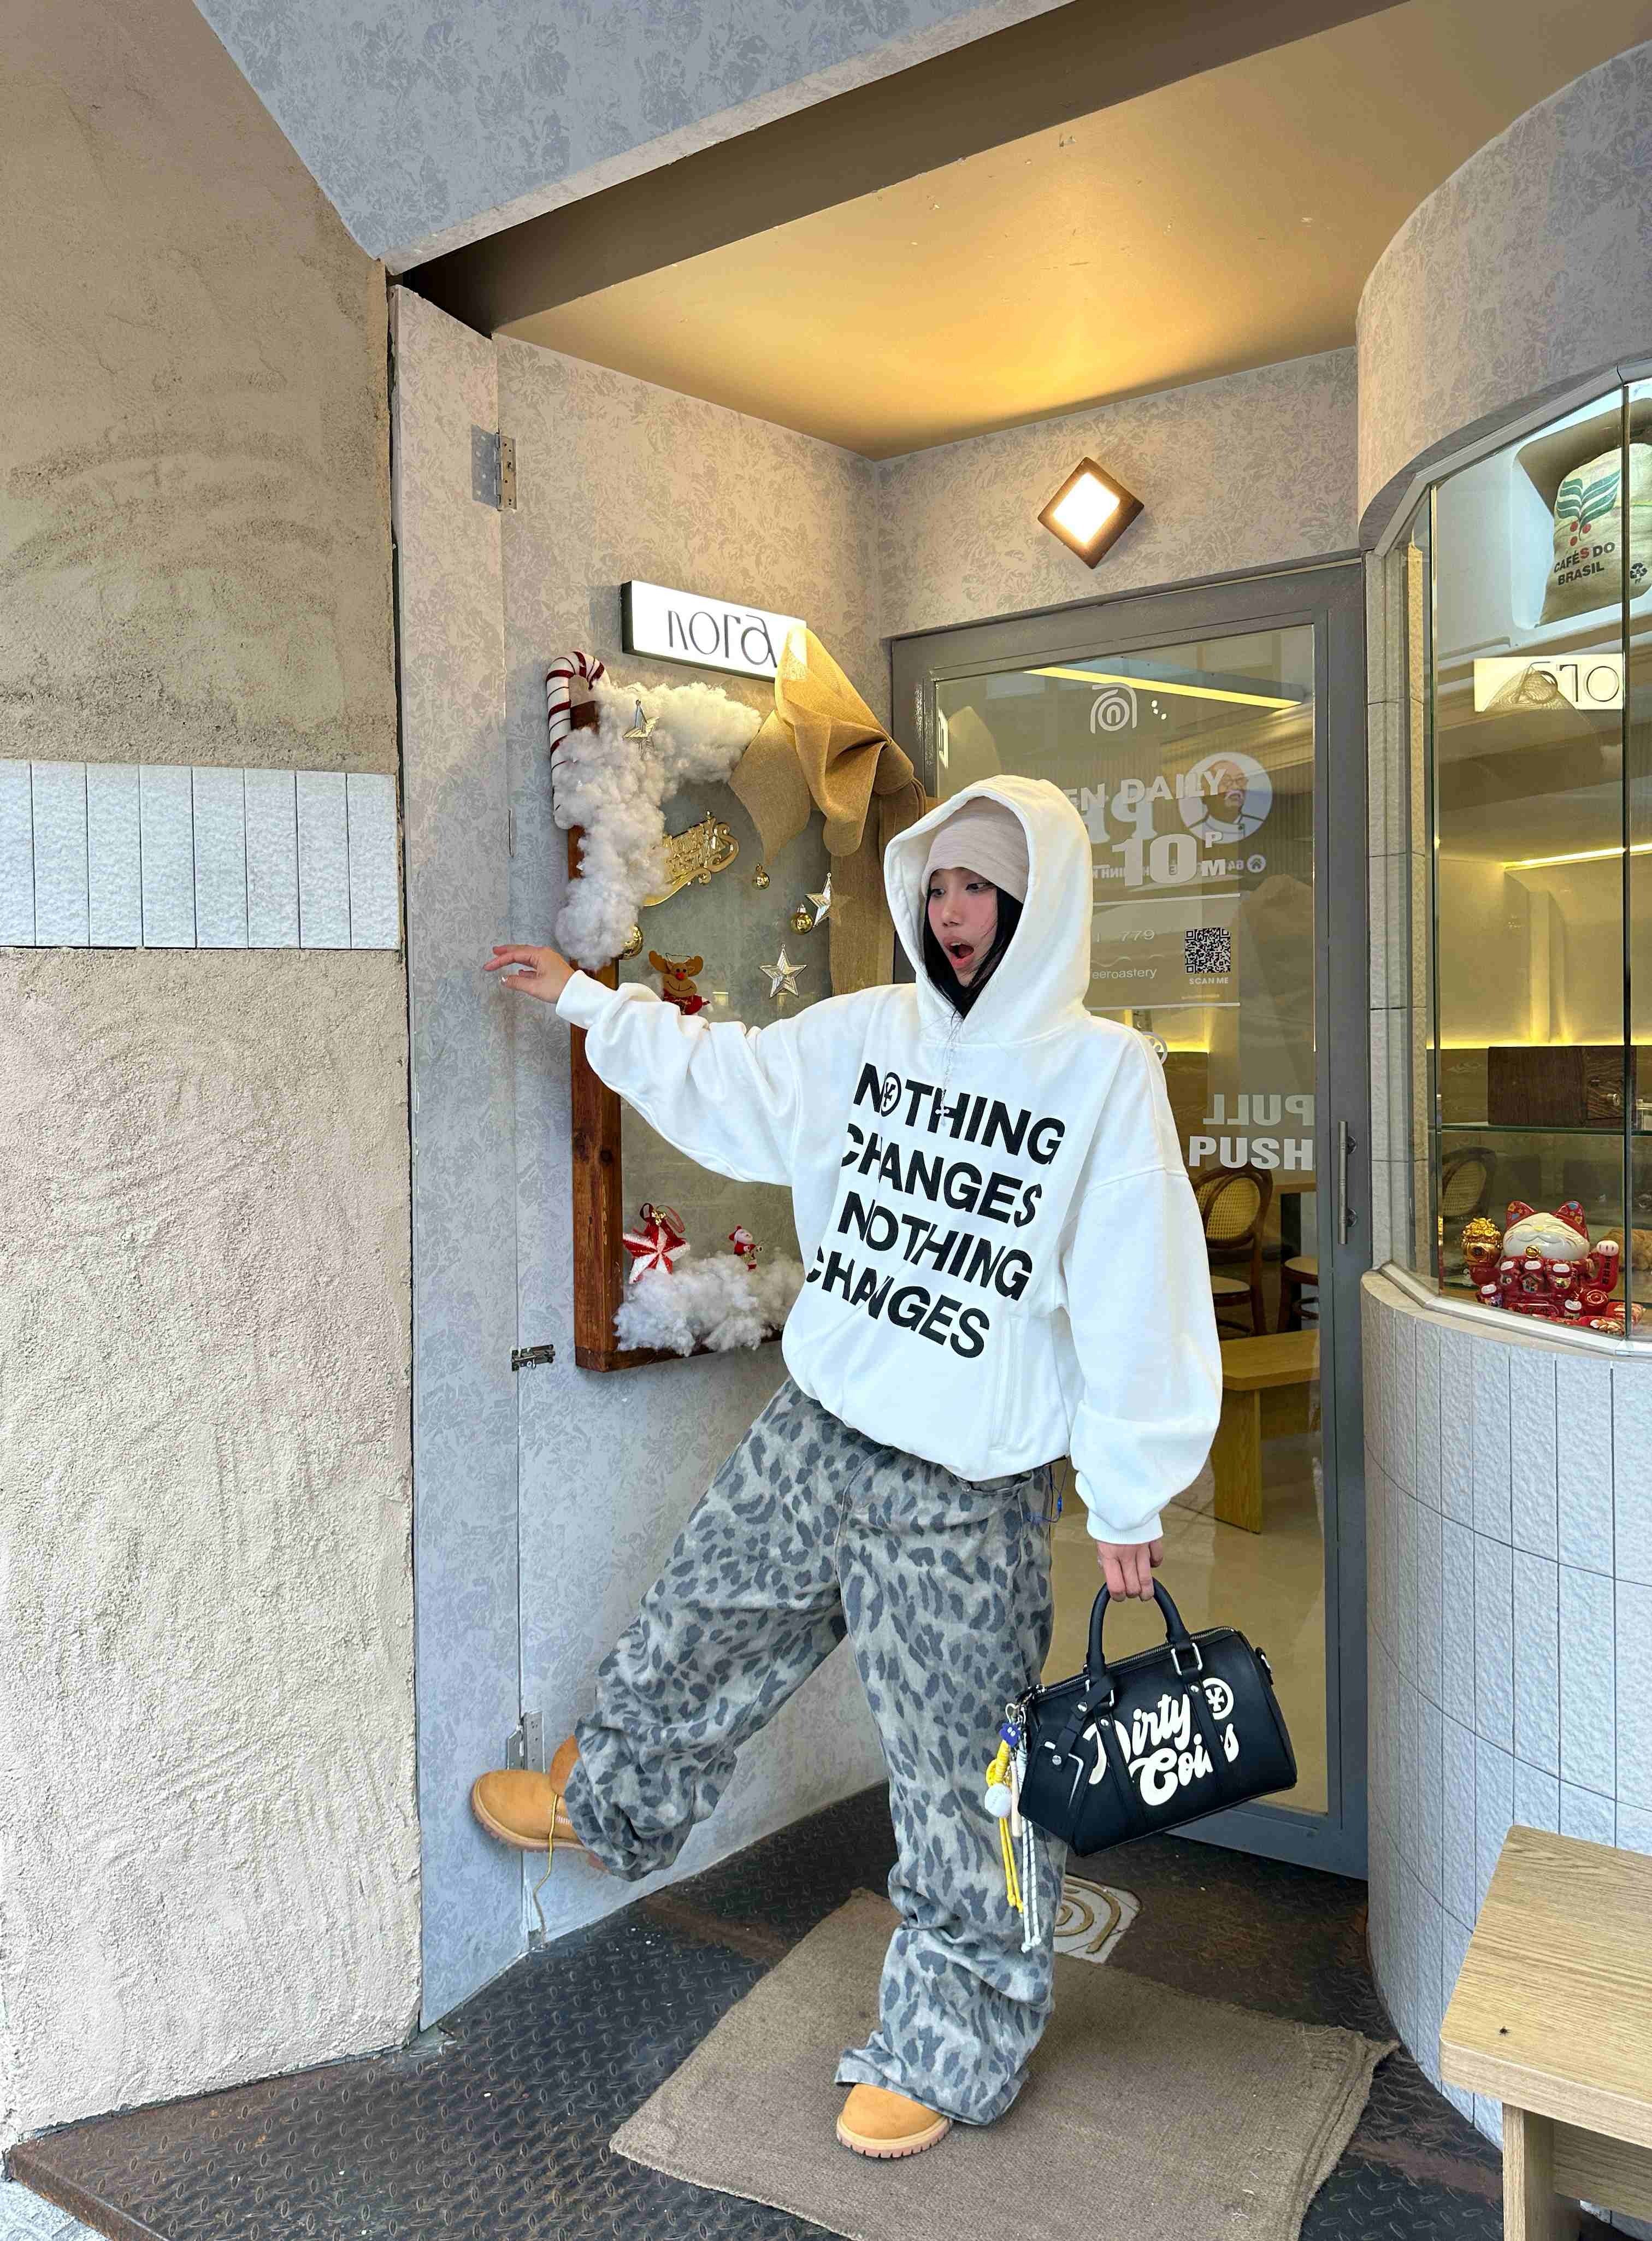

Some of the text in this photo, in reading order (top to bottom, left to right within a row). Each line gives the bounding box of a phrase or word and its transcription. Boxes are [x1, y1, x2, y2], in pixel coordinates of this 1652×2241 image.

[1554, 542, 1615, 573] CAFÉS DO
[1557, 561, 1604, 586] BRASIL
[667, 610, 778, 668] nora
[1062, 782, 1105, 811] EN
[1120, 769, 1227, 805] DAILY
[1111, 833, 1197, 887] 10
[1091, 966, 1158, 980] eeroastery
[853, 1063, 1065, 1165] NOTHING
[1189, 1136, 1313, 1171] PUSH
[837, 1190, 1032, 1301] NOTHING
